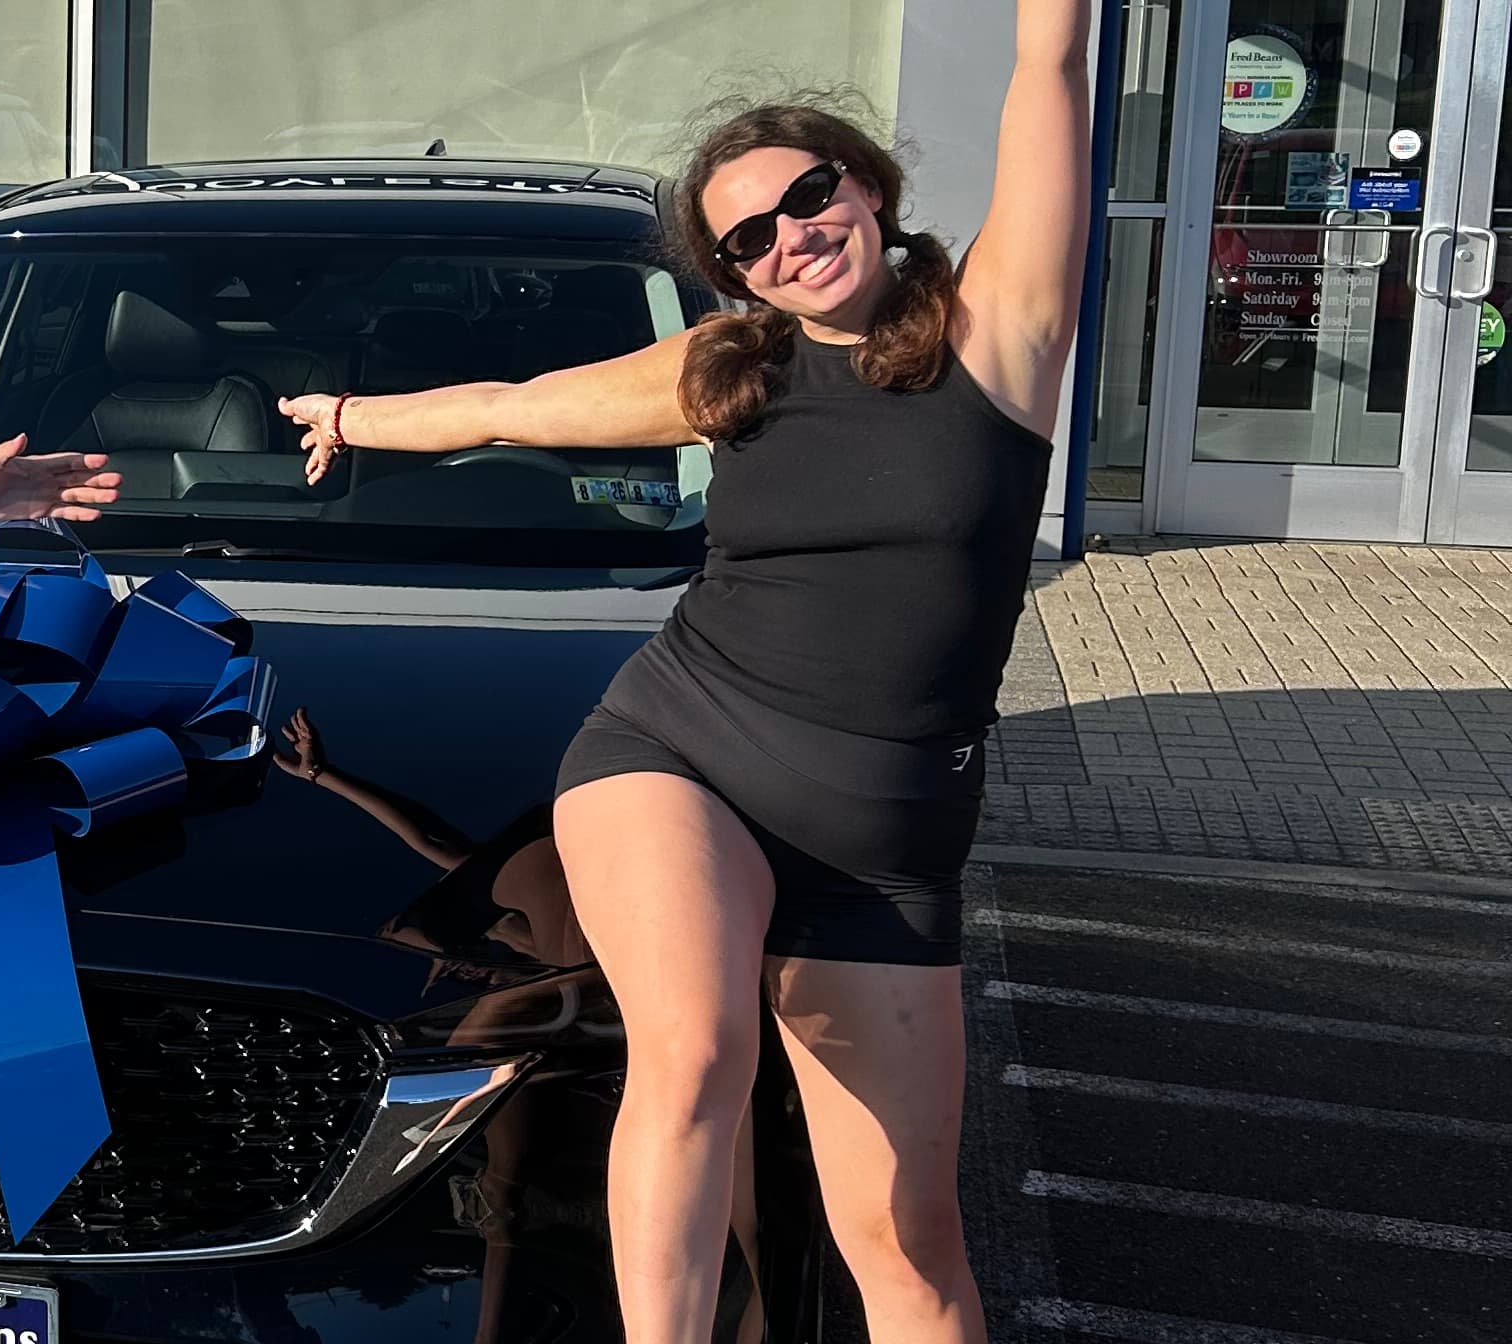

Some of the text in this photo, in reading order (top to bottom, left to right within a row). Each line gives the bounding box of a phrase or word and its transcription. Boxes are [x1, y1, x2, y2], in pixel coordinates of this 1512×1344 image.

[1246, 249, 1318, 264] Showroom
[1244, 271, 1303, 286] Mon.-Fri.
[1241, 290, 1301, 309] Saturday
[1240, 311, 1288, 328] Sunday
